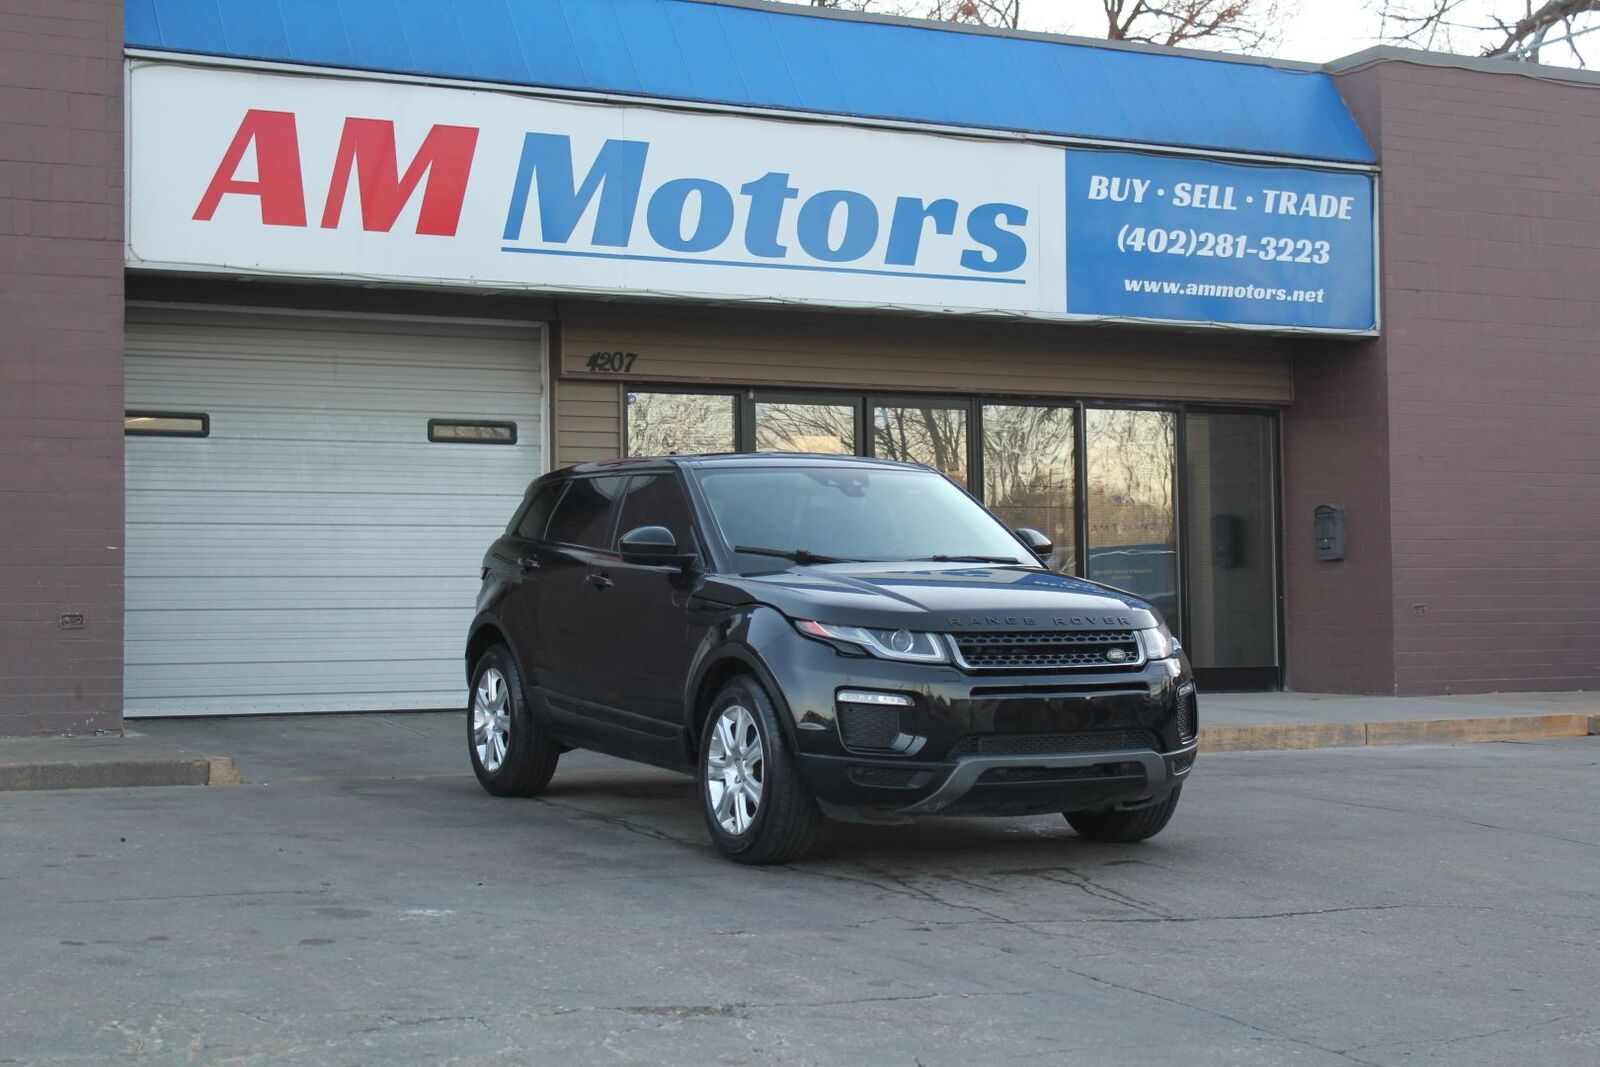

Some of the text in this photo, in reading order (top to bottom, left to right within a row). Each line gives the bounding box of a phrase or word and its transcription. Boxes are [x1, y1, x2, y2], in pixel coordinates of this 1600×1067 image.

[193, 109, 1028, 272] AM Motors
[1087, 175, 1355, 220] BUY SELL TRADE
[1117, 223, 1331, 265] (402)281-3223
[1123, 279, 1326, 304] www.ammotors.net
[586, 351, 639, 373] 4207
[948, 614, 1132, 627] RANGE ROVER
